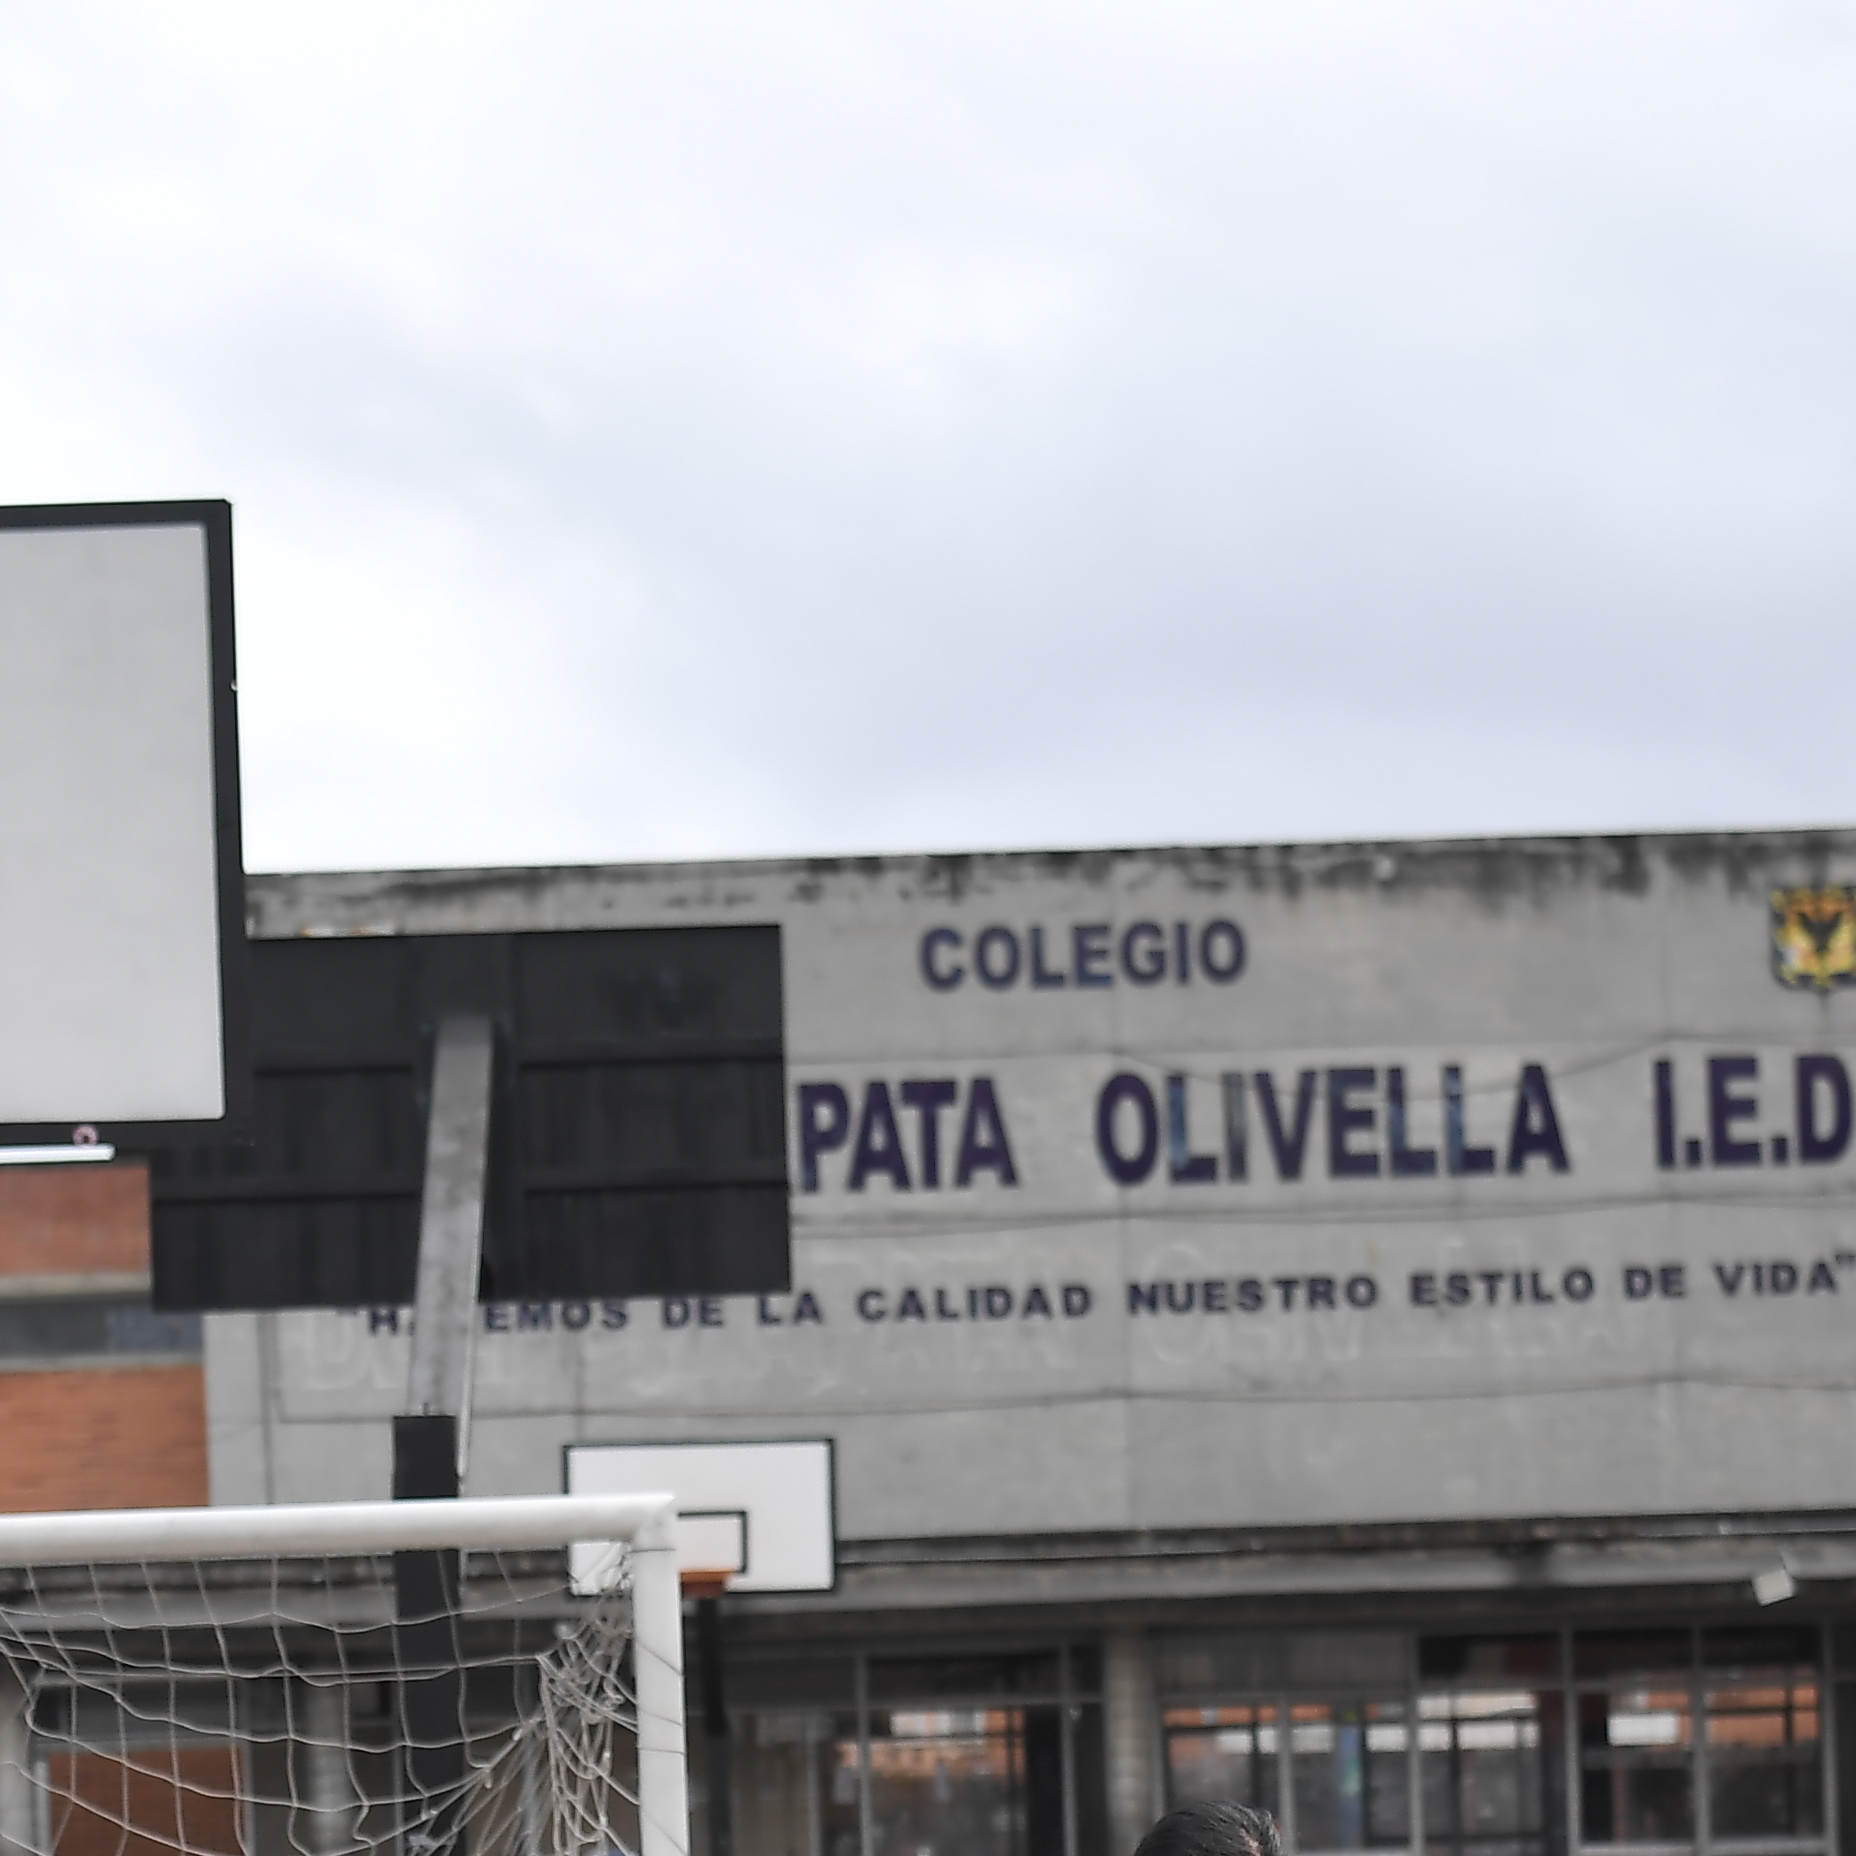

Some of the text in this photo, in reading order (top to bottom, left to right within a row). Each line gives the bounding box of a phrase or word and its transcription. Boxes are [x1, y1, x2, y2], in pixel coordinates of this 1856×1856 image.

[918, 917, 1247, 992] COLEGIO
[1095, 1062, 1572, 1187] OLIVELLA
[661, 1297, 724, 1329] DE
[756, 1291, 823, 1325] LA
[855, 1285, 1092, 1322] CALIDAD
[1127, 1275, 1377, 1313] NUESTRO
[1409, 1270, 1593, 1308] ESTILO
[1624, 1265, 1684, 1299] DE
